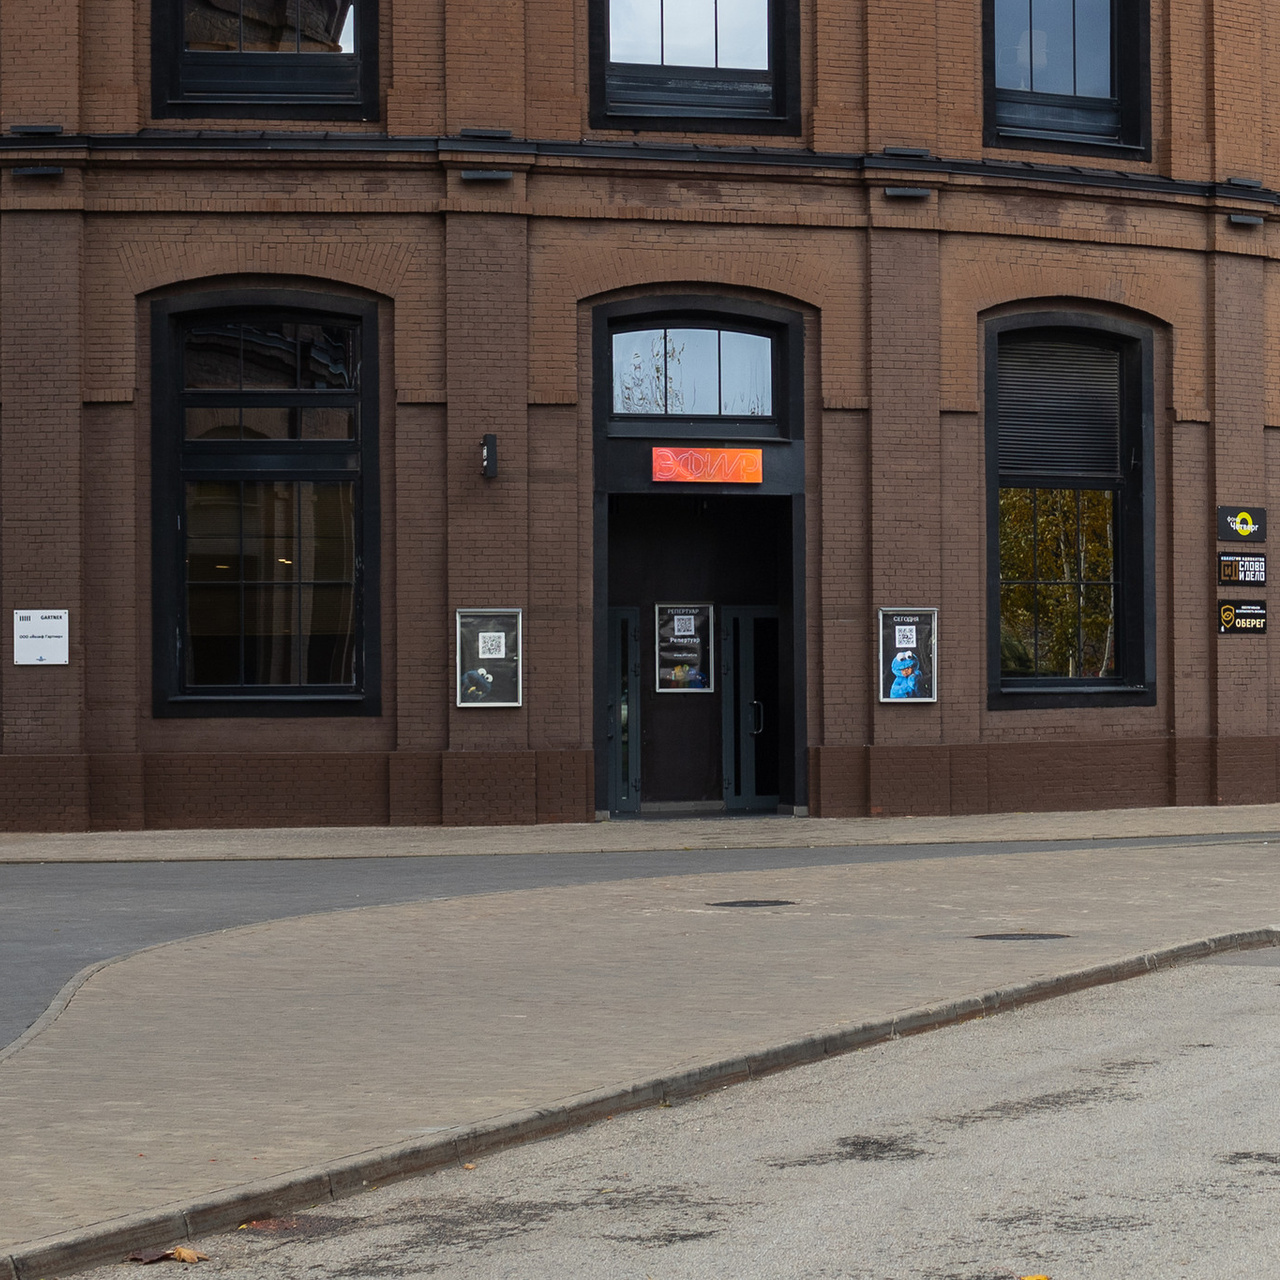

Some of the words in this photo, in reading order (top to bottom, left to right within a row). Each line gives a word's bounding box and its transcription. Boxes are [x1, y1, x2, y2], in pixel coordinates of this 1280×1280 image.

[657, 449, 759, 480] ЭФИР
[1239, 561, 1265, 571] СЛОВО
[1239, 571, 1244, 581] И
[1245, 571, 1265, 581] ДЕЛО
[1235, 618, 1265, 628] ОБЕРЕГ
